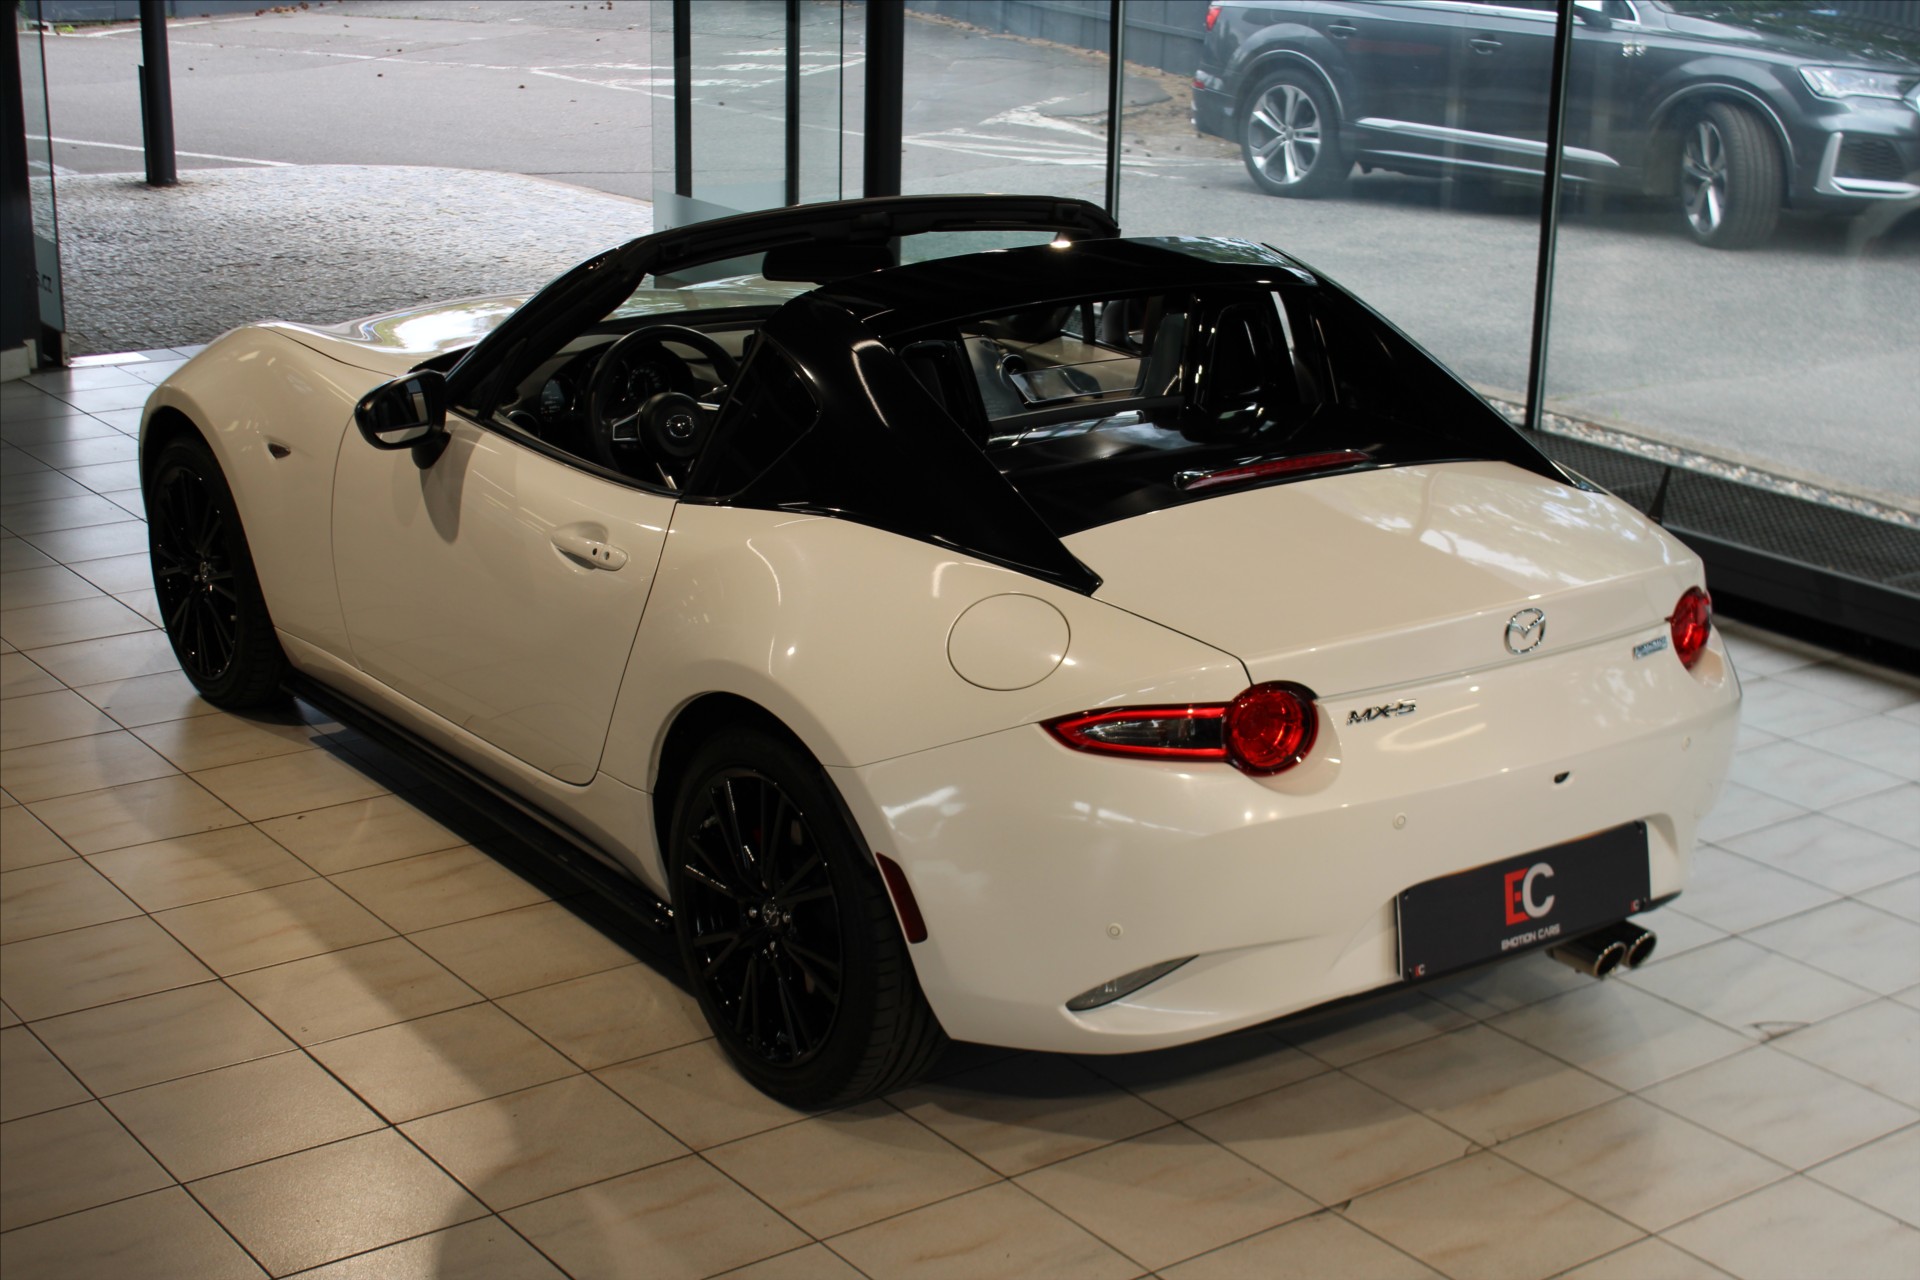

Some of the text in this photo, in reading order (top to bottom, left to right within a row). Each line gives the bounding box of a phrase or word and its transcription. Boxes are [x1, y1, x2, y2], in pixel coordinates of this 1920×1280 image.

[1346, 699, 1416, 725] MX-5
[1504, 862, 1555, 926] EC
[1501, 923, 1560, 951] EMOTION CARS
